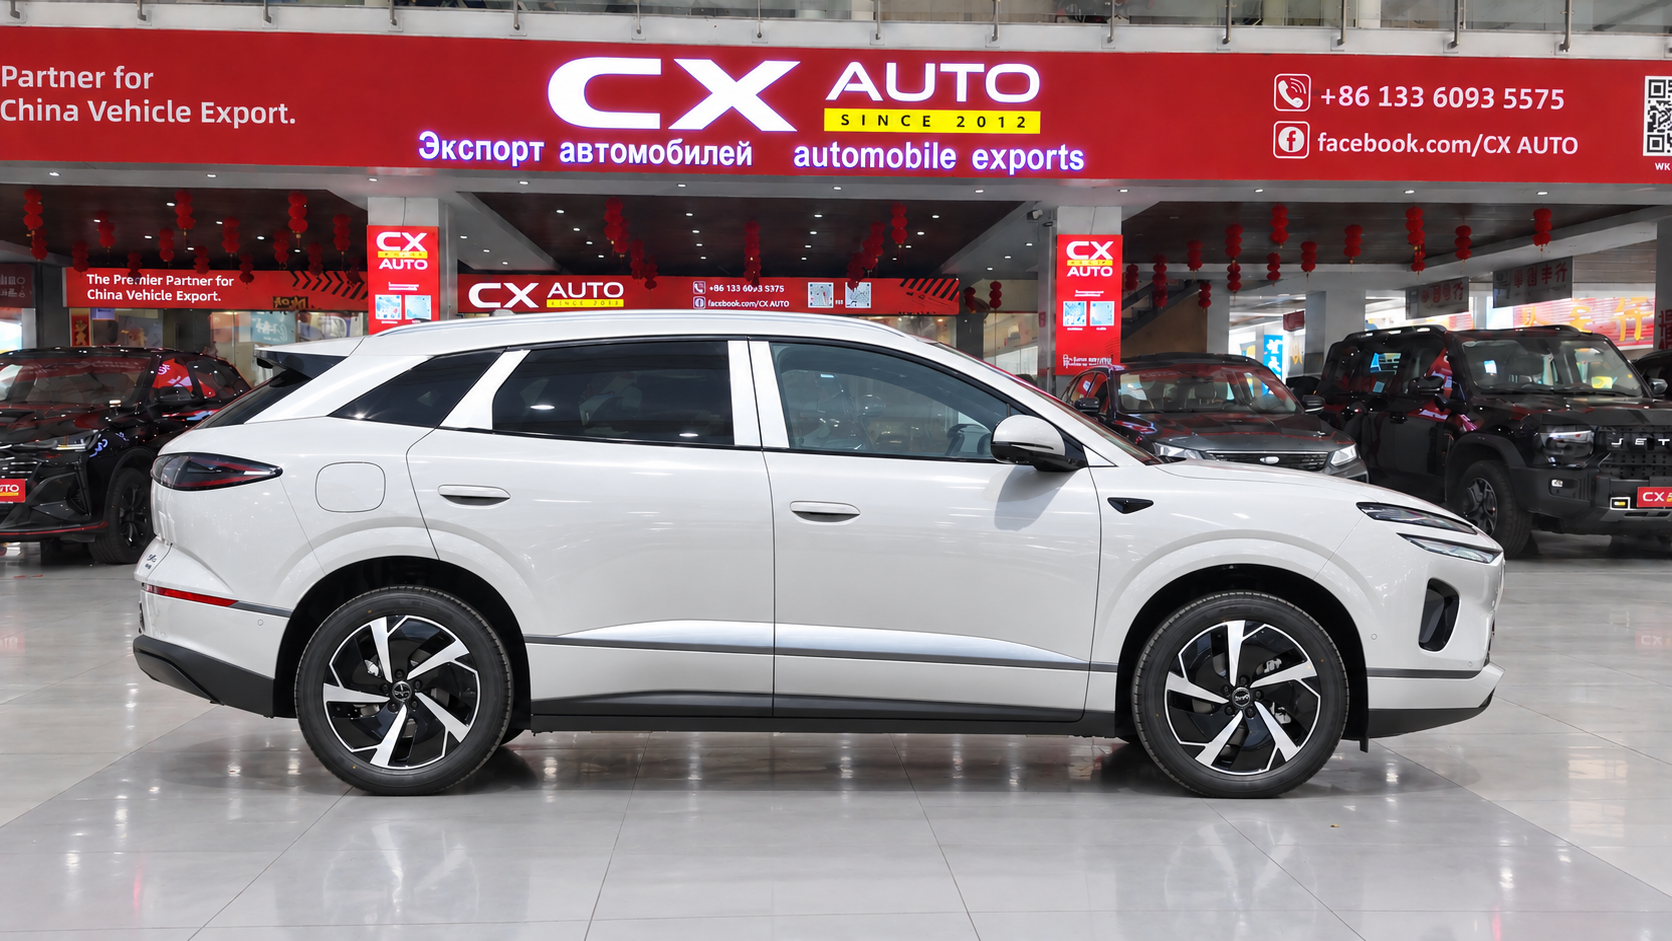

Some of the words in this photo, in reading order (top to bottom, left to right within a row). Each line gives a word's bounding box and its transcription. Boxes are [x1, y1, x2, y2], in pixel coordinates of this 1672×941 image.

[1, 65, 106, 88] Partner
[114, 66, 154, 89] for
[546, 56, 801, 132] CX
[825, 61, 1041, 103] AUTO
[1320, 85, 1370, 107] +86
[1378, 86, 1424, 107] 133
[1433, 87, 1495, 109] 6093
[1503, 88, 1565, 110] 5575
[0, 98, 79, 122] China
[87, 100, 192, 123] Vehicle
[201, 102, 296, 129] Export.
[841, 114, 931, 128] SINCE
[956, 116, 1026, 128] 2012
[418, 131, 545, 167] Экспорт
[559, 138, 753, 166] автомобилей
[1317, 132, 1511, 157] facebook.com/CX
[1517, 136, 1579, 155] AUTO
[794, 142, 957, 170] automobile
[972, 144, 1085, 176] exports
[376, 231, 428, 252] CX
[1066, 240, 1114, 260] CX
[378, 258, 428, 270] AUTO
[1067, 266, 1114, 277] AUTO
[86, 274, 110, 285] The
[113, 274, 163, 286] Premier
[166, 275, 213, 287] Partner
[216, 275, 235, 287] for
[87, 289, 123, 300] China
[126, 289, 173, 301] Vehicle
[176, 290, 221, 303] Export.
[468, 282, 540, 309] CX
[547, 282, 625, 299] AUTO
[1642, 491, 1665, 502] CX
